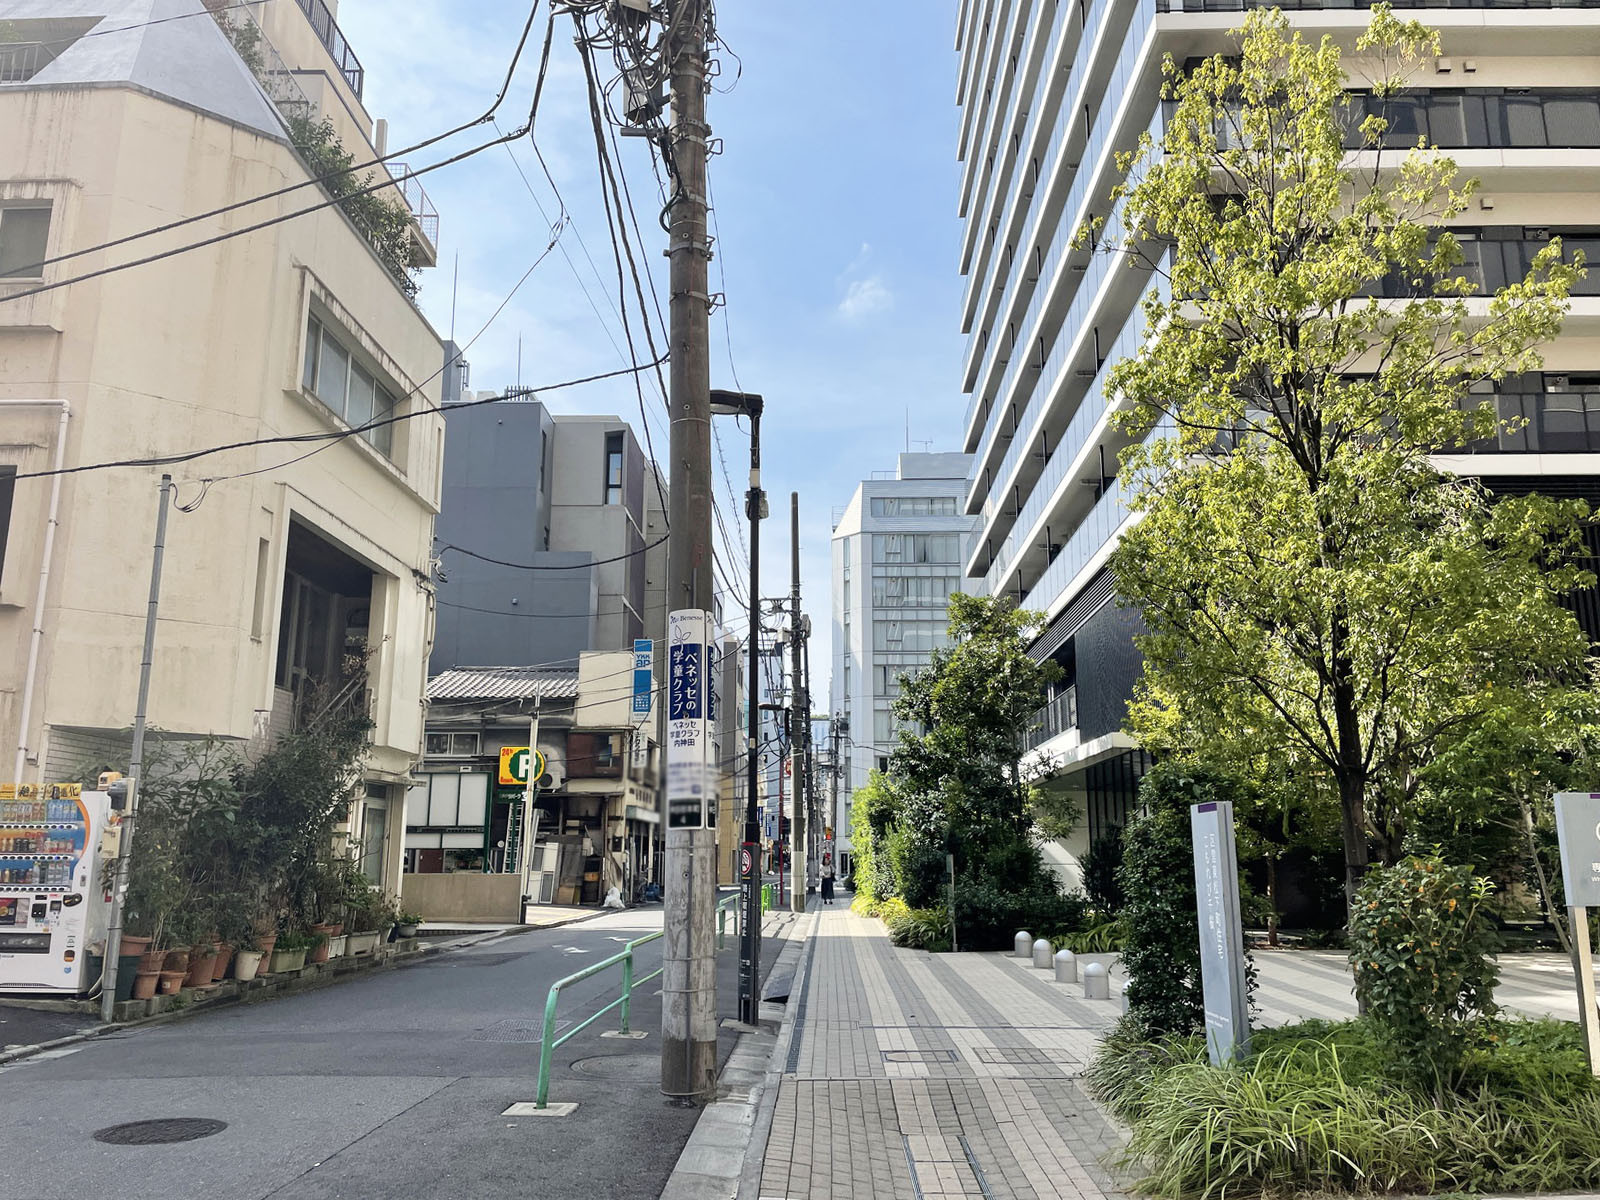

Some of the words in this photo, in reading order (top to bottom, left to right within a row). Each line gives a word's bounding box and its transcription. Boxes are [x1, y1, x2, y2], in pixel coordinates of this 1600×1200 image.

[673, 650, 684, 715] 学童クラブ
[684, 652, 698, 710] ベネッセの
[673, 720, 697, 729] ベネッセ
[670, 729, 701, 739] 学童クラブ
[674, 738, 696, 748] 内神田
[518, 754, 537, 778] P
